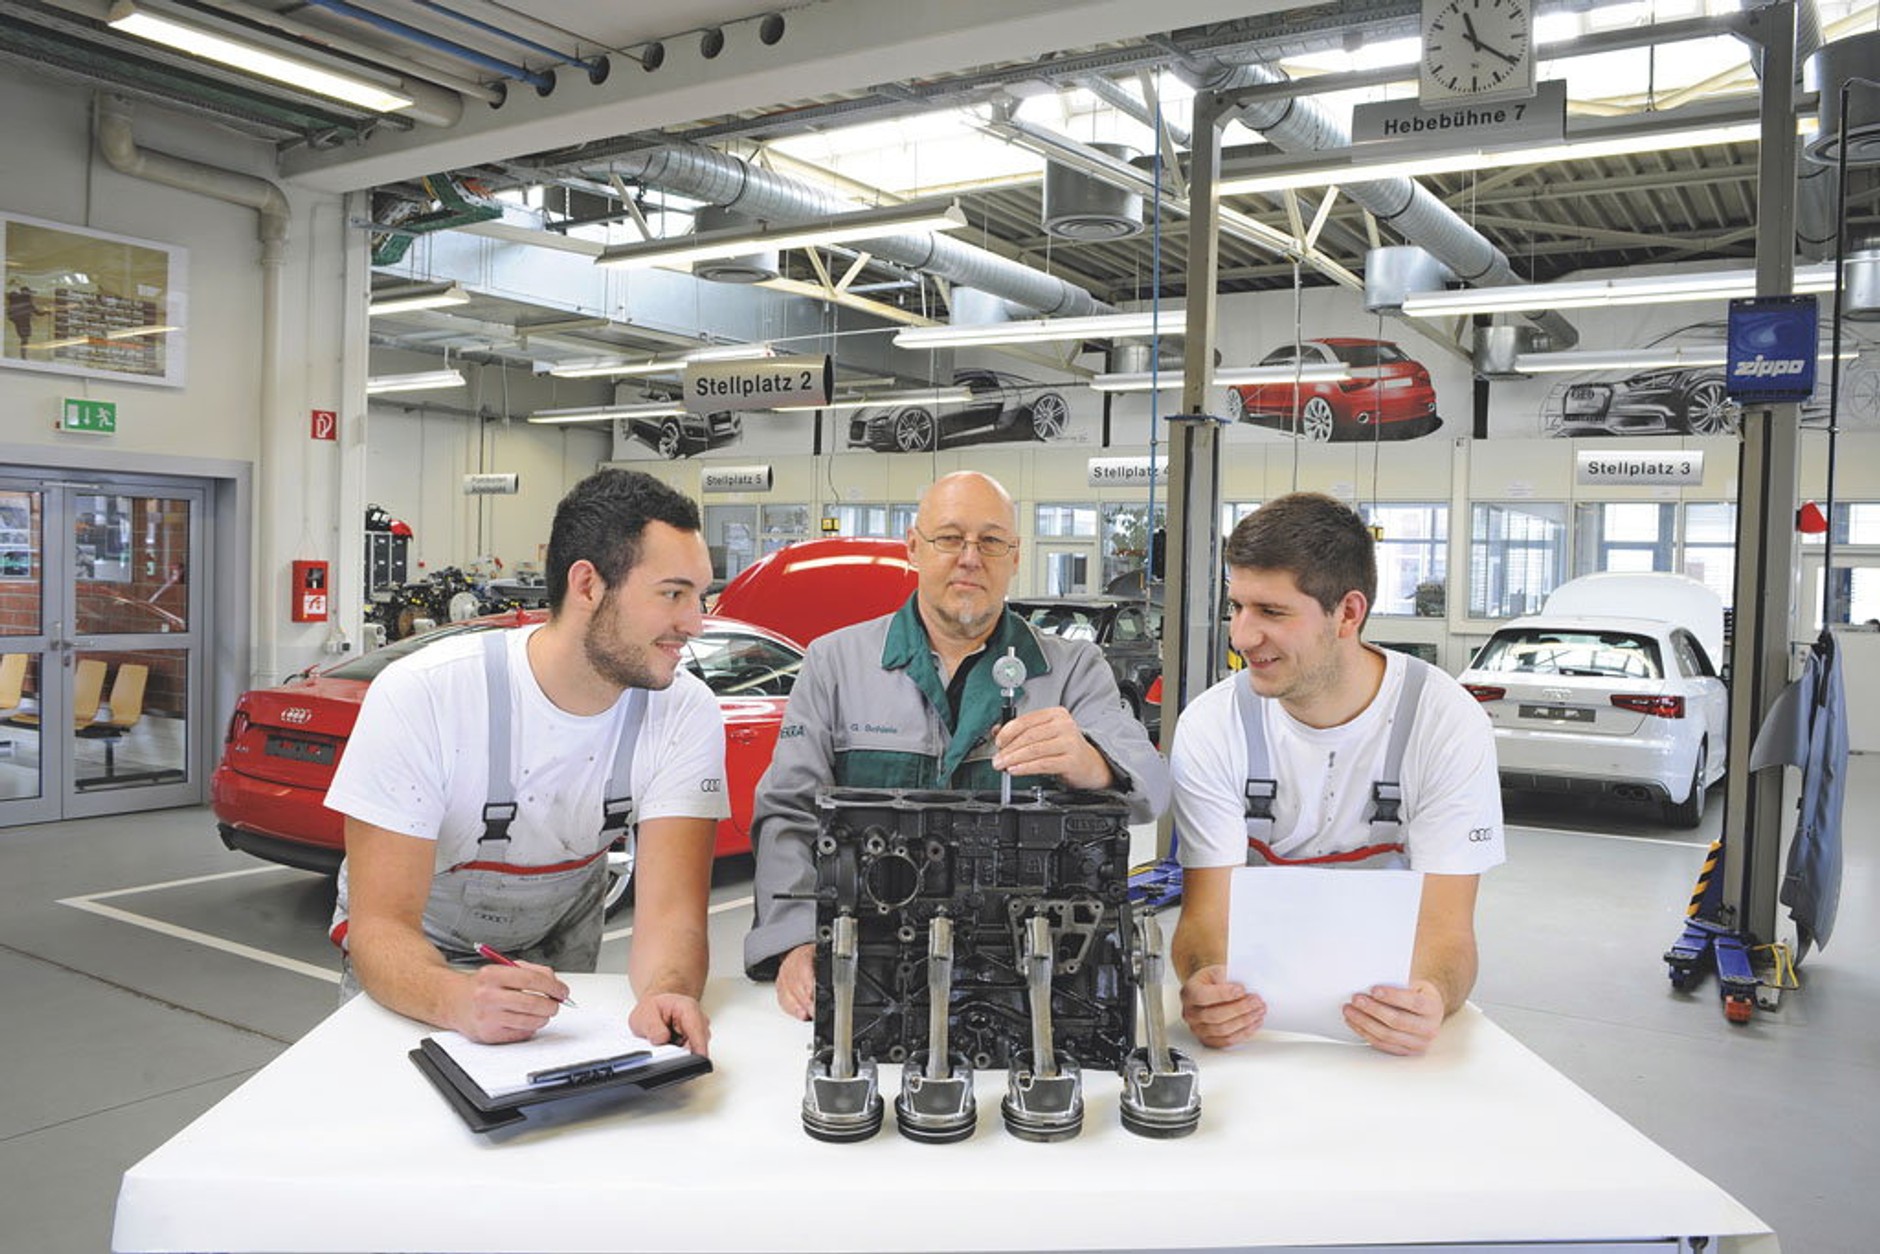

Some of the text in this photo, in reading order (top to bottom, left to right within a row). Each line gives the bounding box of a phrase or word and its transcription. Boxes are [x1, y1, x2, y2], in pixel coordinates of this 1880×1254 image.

[1384, 103, 1526, 135] Hebebühne 7
[1733, 354, 1805, 377] zippo
[696, 371, 812, 397] Stellplatz 2
[1094, 466, 1158, 479] Stellplatz
[1588, 461, 1691, 476] Stellplatz 3
[706, 473, 762, 486] Stellplatz 5
